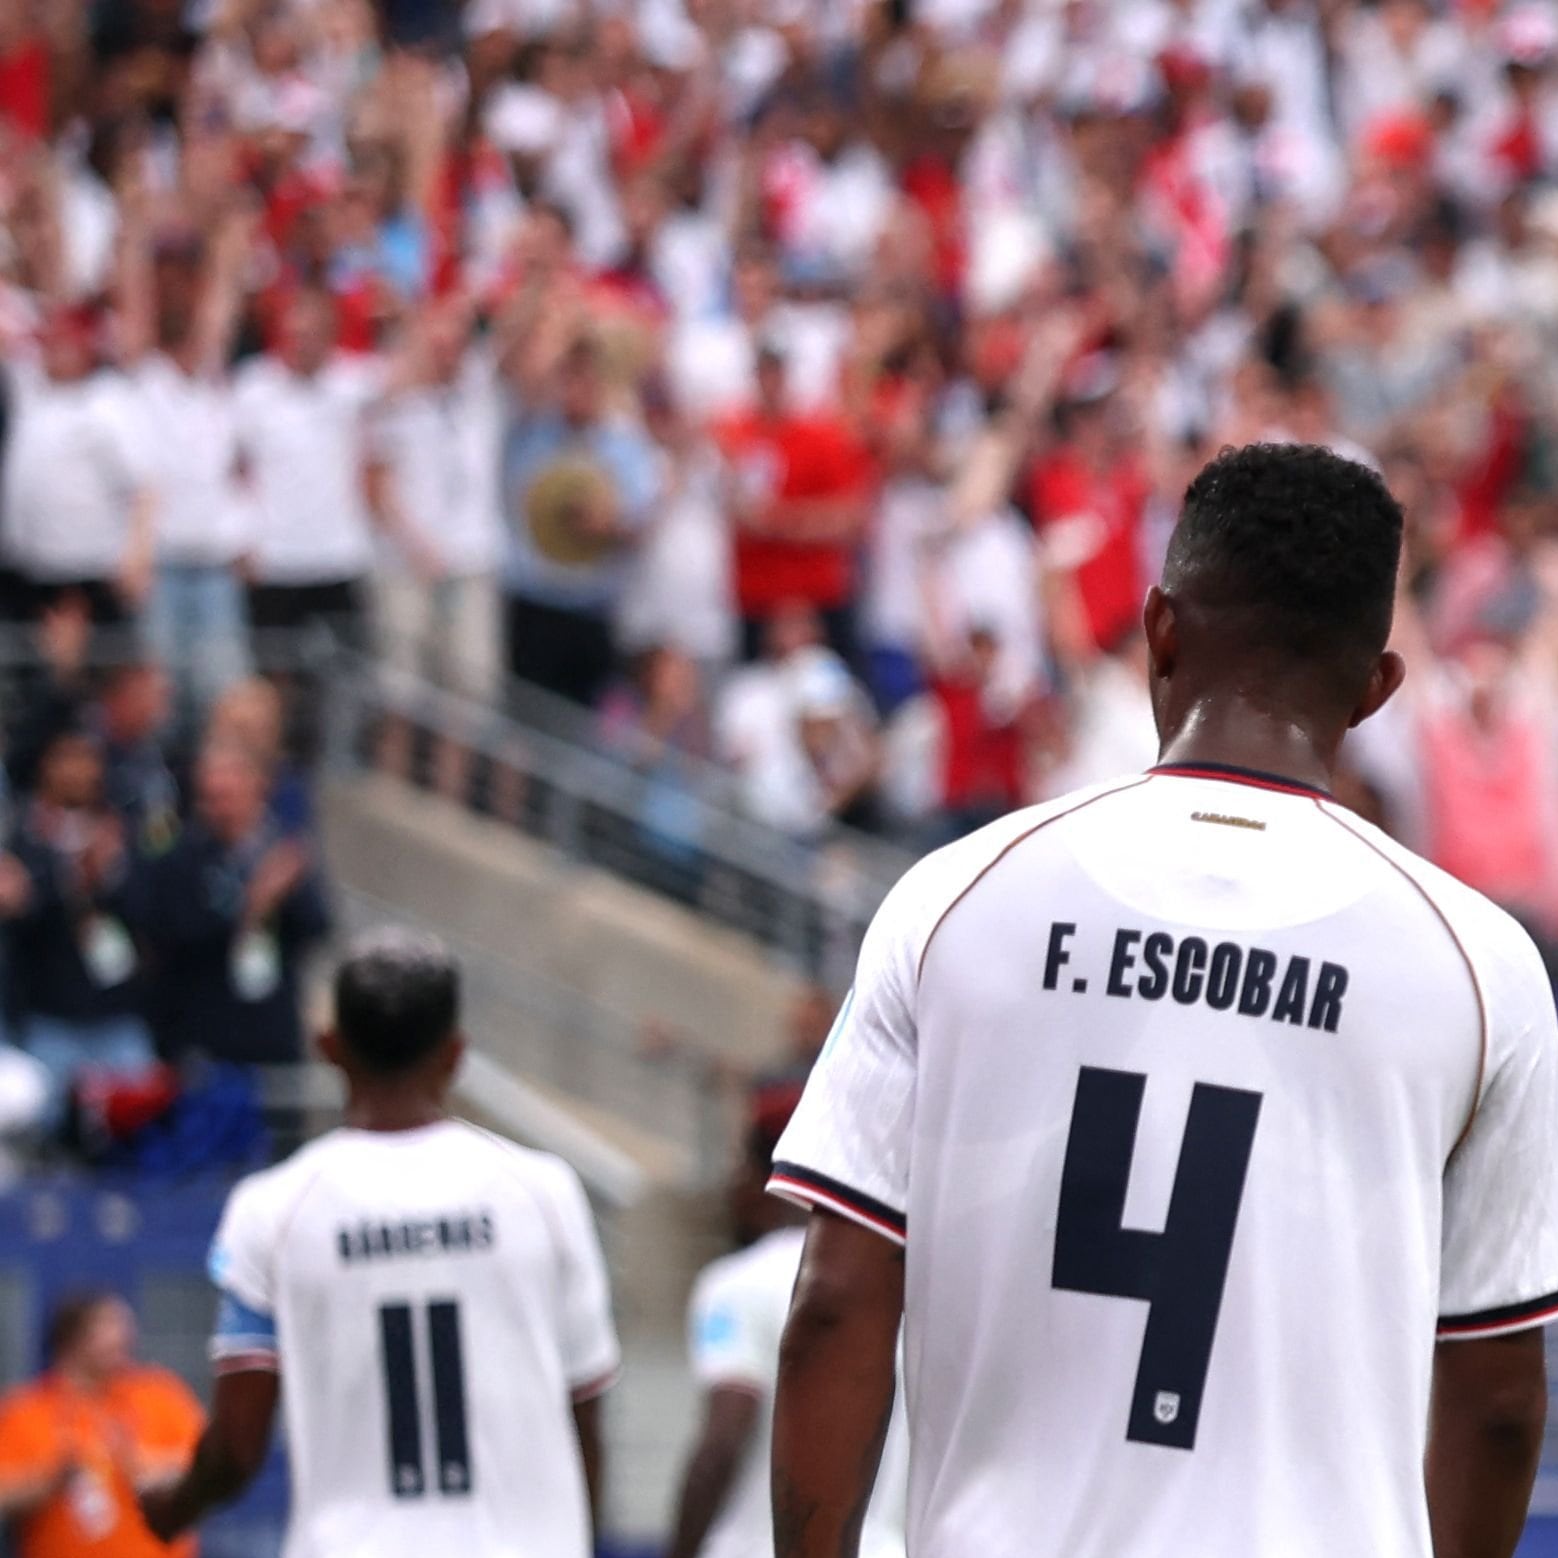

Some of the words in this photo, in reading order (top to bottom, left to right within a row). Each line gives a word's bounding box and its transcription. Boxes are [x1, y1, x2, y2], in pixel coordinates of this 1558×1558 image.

[1043, 921, 1088, 993] F.
[1106, 928, 1349, 1034] ESCOBAR
[1051, 1065, 1264, 1451] 4
[378, 1299, 471, 1497] 11
